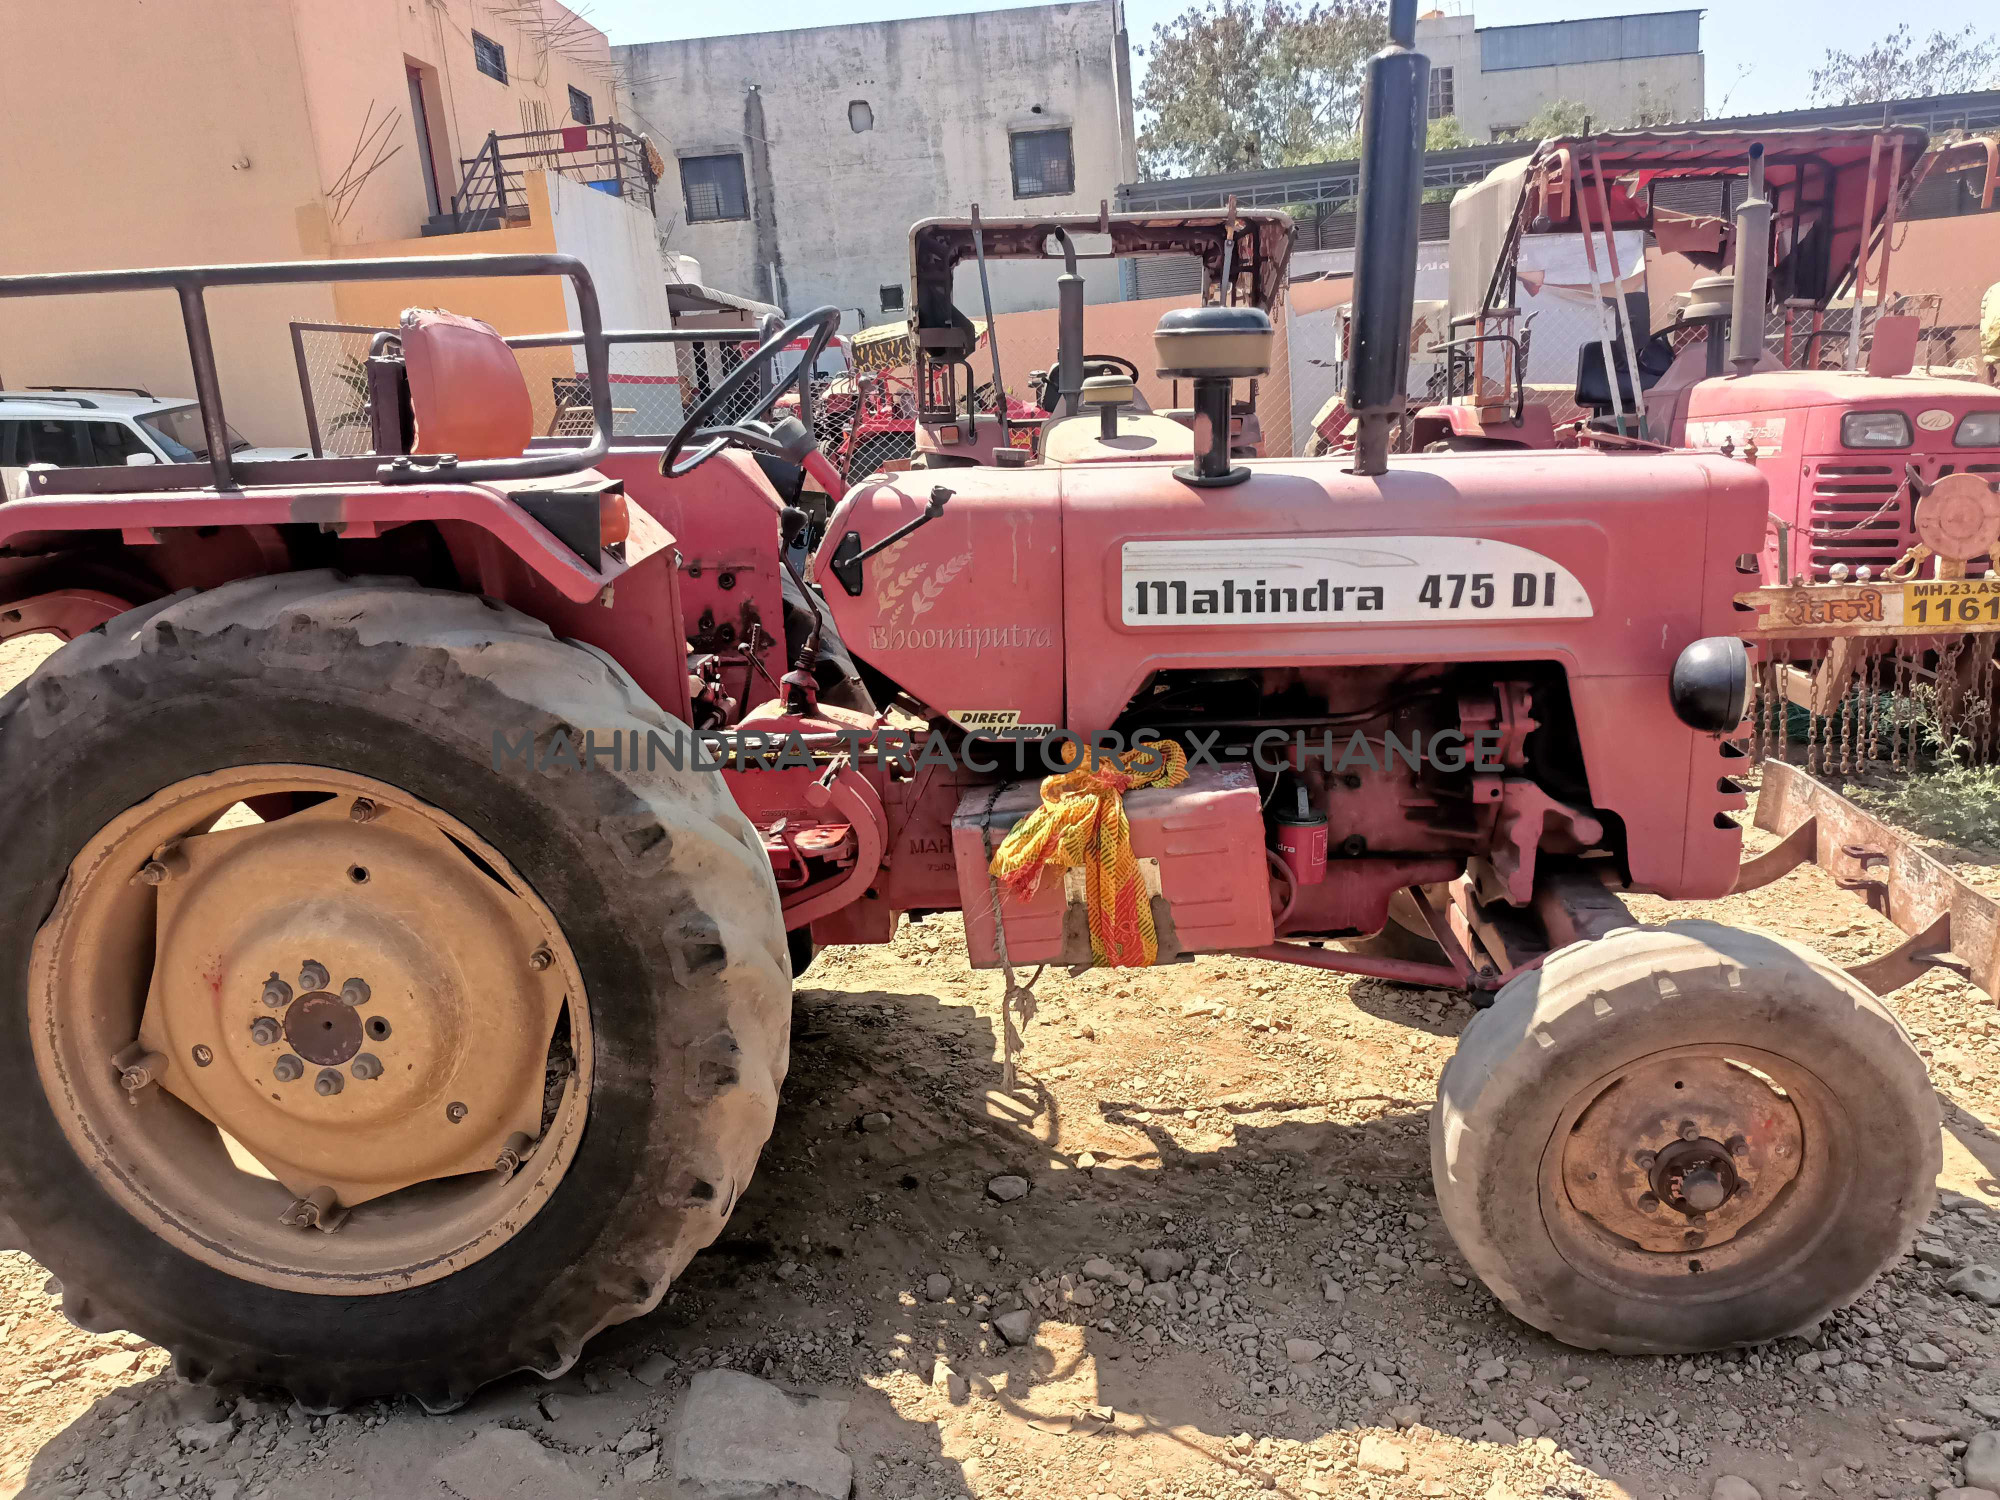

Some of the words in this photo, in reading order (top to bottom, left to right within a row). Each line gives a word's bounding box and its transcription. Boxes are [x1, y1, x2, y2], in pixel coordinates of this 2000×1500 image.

[1134, 578, 1385, 615] Mahindra
[1418, 573, 1495, 609] 475
[1512, 572, 1556, 608] DI
[1912, 597, 2000, 623] 1161
[869, 624, 1053, 659] Bhoomiputra
[960, 713, 1017, 723] DIRECT
